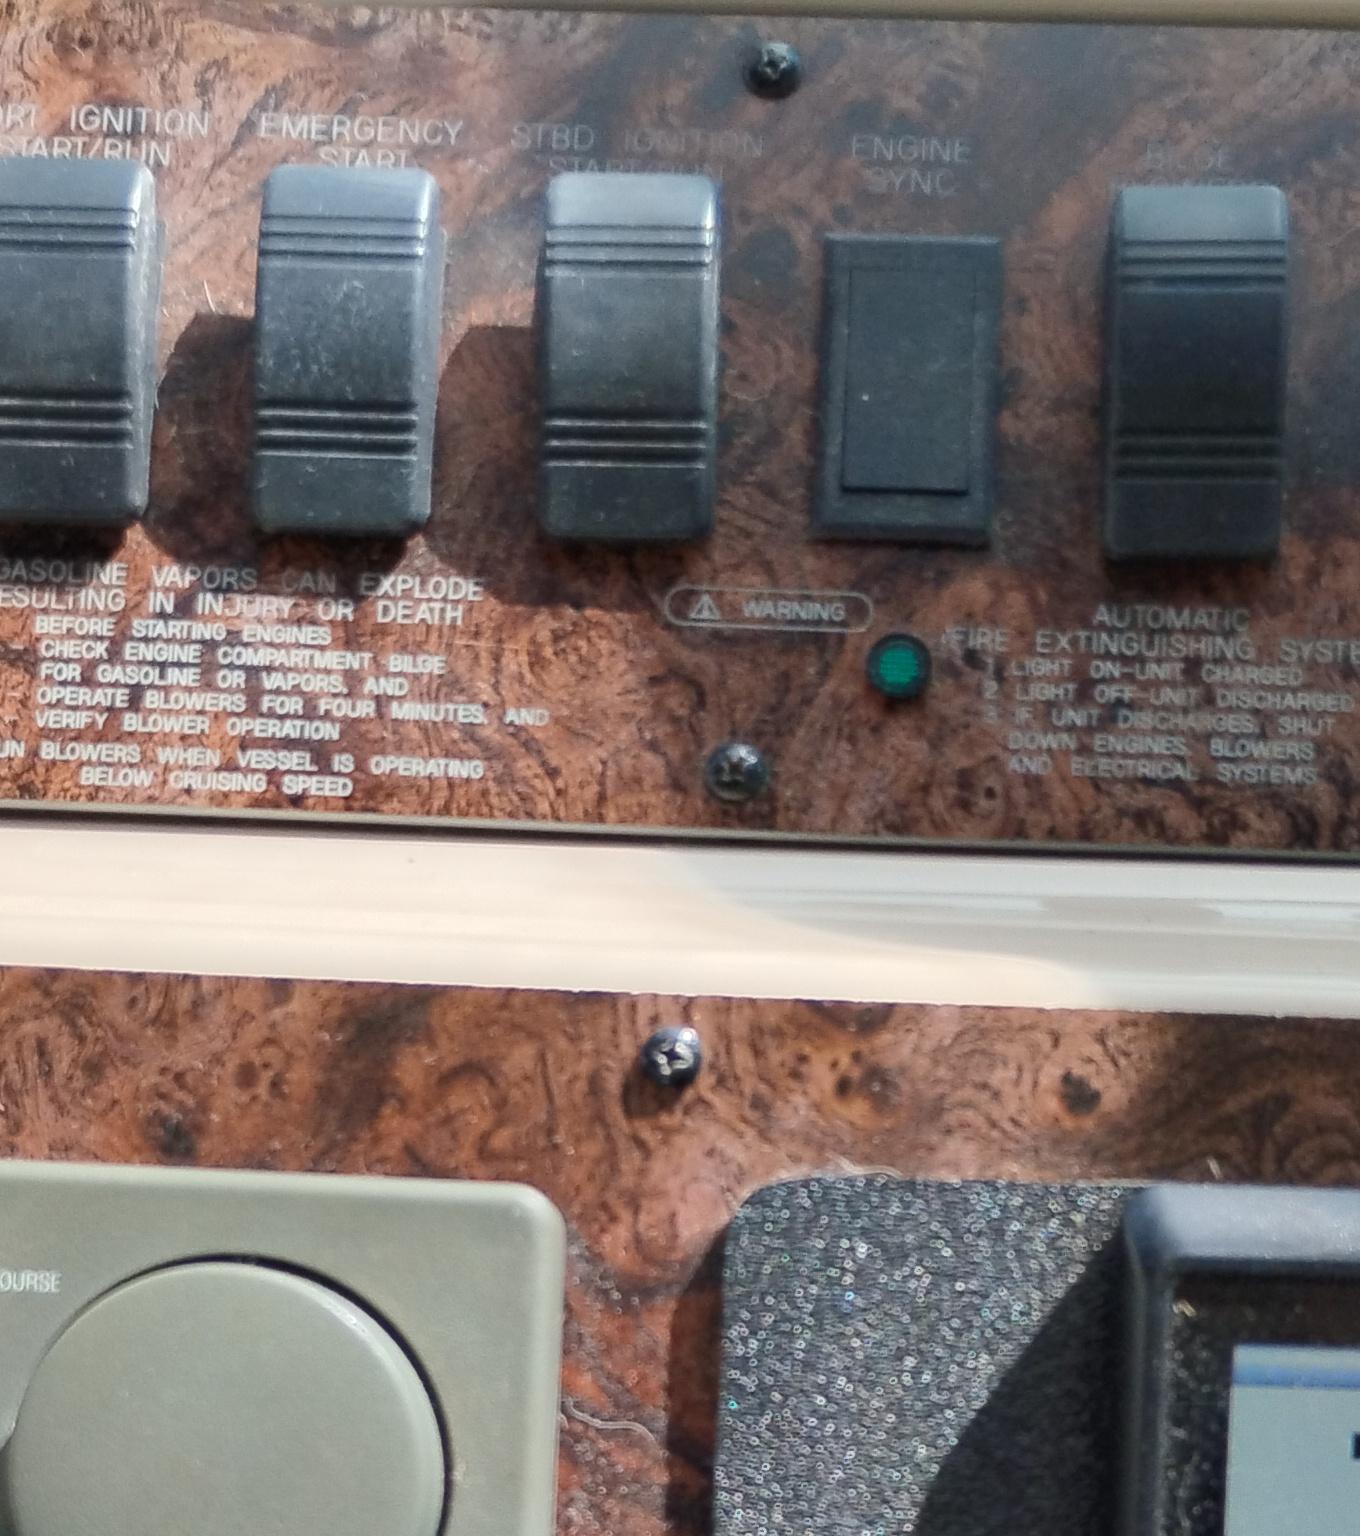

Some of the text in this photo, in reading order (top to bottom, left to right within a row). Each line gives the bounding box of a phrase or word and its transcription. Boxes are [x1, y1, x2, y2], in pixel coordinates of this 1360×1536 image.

[70, 104, 210, 136] IGNITION
[258, 113, 464, 146] EMERGENCY
[510, 122, 595, 150] STBD
[851, 133, 970, 162] ENGINE
[152, 565, 258, 589] VAPORS
[282, 572, 336, 593] CAN
[361, 574, 483, 600] EXPLODE
[149, 592, 174, 613] IN
[197, 592, 294, 619] INJURY
[318, 600, 354, 621] OR
[377, 601, 462, 625] DEATH
[744, 601, 845, 621] WARNING
[1093, 604, 1250, 631] AUTOMATIC
[35, 616, 331, 645] BEFORE STARTING ENGINES
[943, 625, 1009, 650] FIRE
[1035, 630, 1256, 660] EXTINGUISHING
[40, 640, 447, 674] CHECK ENGINE COMPARTMENT BILGE
[1010, 658, 1072, 676] LIGHT
[1201, 664, 1302, 686] CHARGED
[40, 662, 81, 682] FOR
[97, 665, 201, 687] GASOLINE
[217, 670, 246, 689] OR
[364, 676, 409, 696] AND
[38, 686, 130, 708] OPERATE
[145, 691, 246, 712] BLOWERS
[262, 696, 304, 716] FOR
[319, 699, 376, 717] FOUR
[504, 708, 549, 725] AND
[984, 681, 998, 699] 2
[1016, 683, 1077, 700] LIGHT
[1216, 689, 1355, 712] DISCHARGED
[36, 711, 340, 741] VERIFY BLOWER OPERATION
[1015, 707, 1033, 724] IF
[1051, 708, 1101, 726] UNIT
[1278, 716, 1334, 736] SHUT
[40, 741, 140, 763] BLOWERS
[158, 745, 221, 767] WHEN
[238, 749, 318, 771] VESSEL
[332, 754, 355, 773] IS
[370, 755, 484, 779] OPERATING
[1009, 733, 1076, 750] DOWN
[1210, 738, 1314, 760] BLOWERS
[80, 766, 353, 797] BELOW CRUISING SPEED
[1009, 755, 1317, 784] AND ELECTRICAL SYSTEMS
